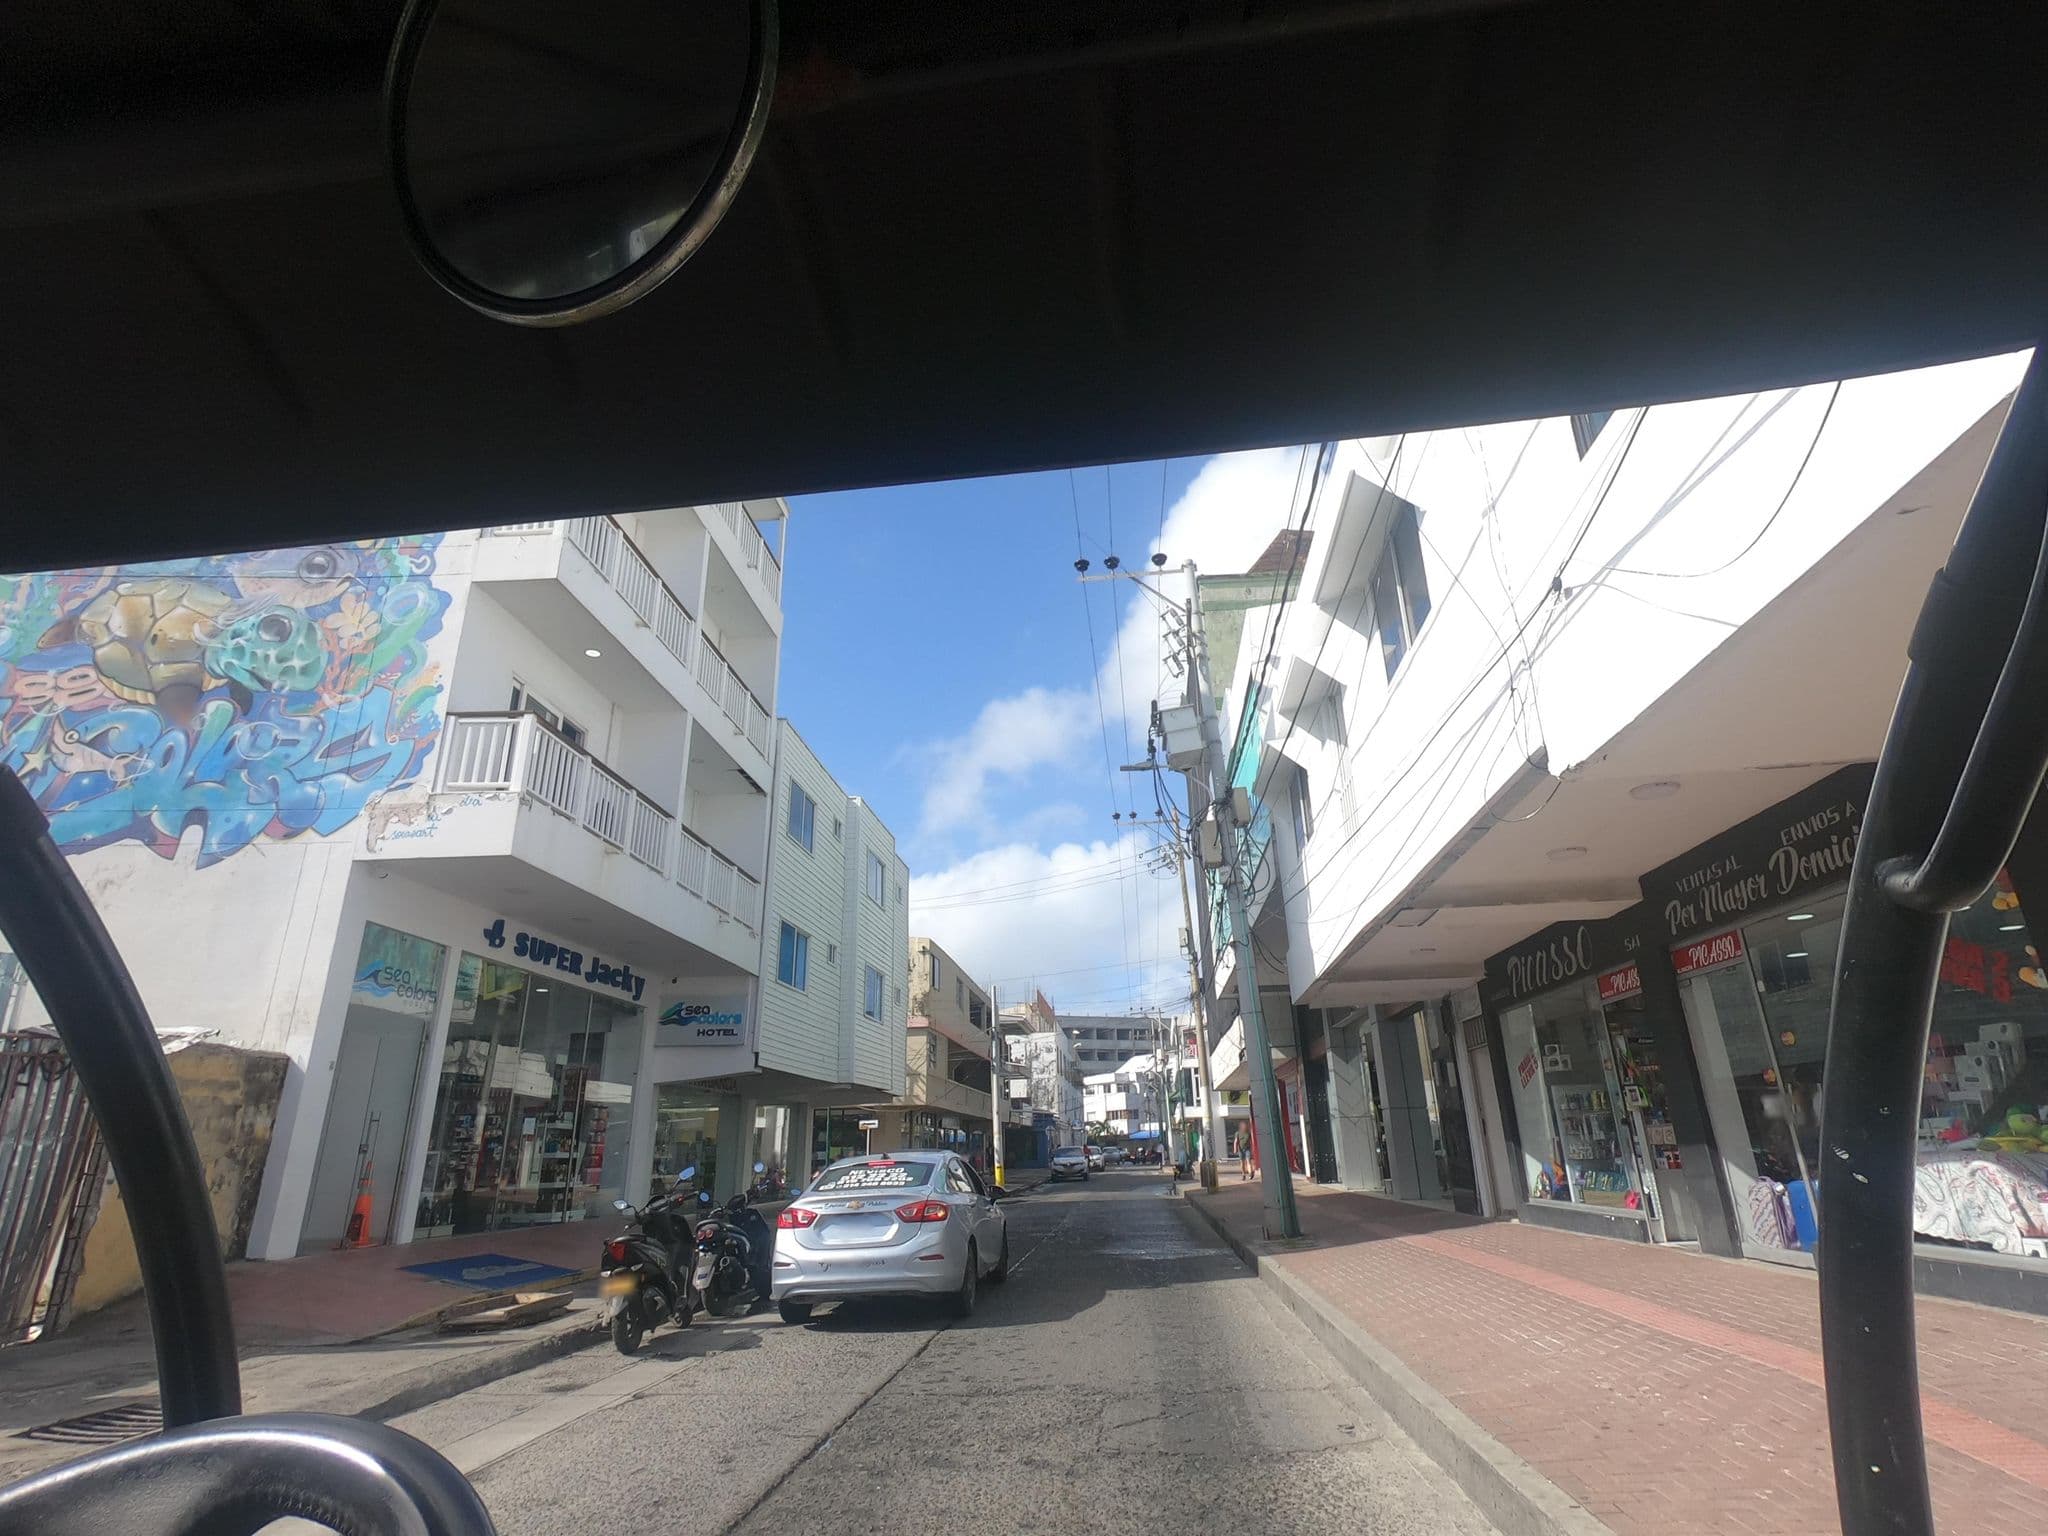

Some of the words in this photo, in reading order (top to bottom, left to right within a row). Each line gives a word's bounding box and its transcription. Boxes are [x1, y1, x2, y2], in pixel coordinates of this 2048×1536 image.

[1780, 805, 1841, 846] ENVIOS
[1845, 800, 1857, 818] A
[1674, 863, 1723, 894] VENTAS
[1725, 854, 1744, 875] AL
[1664, 899, 1698, 936] Por
[1699, 872, 1769, 923] Mayor
[513, 932, 584, 976] SUPER
[584, 957, 646, 1001] Jacky
[1688, 934, 1736, 969] PICASSO
[396, 980, 437, 1004] colors
[696, 1028, 738, 1037] HOTEL
[698, 1011, 742, 1025] colors
